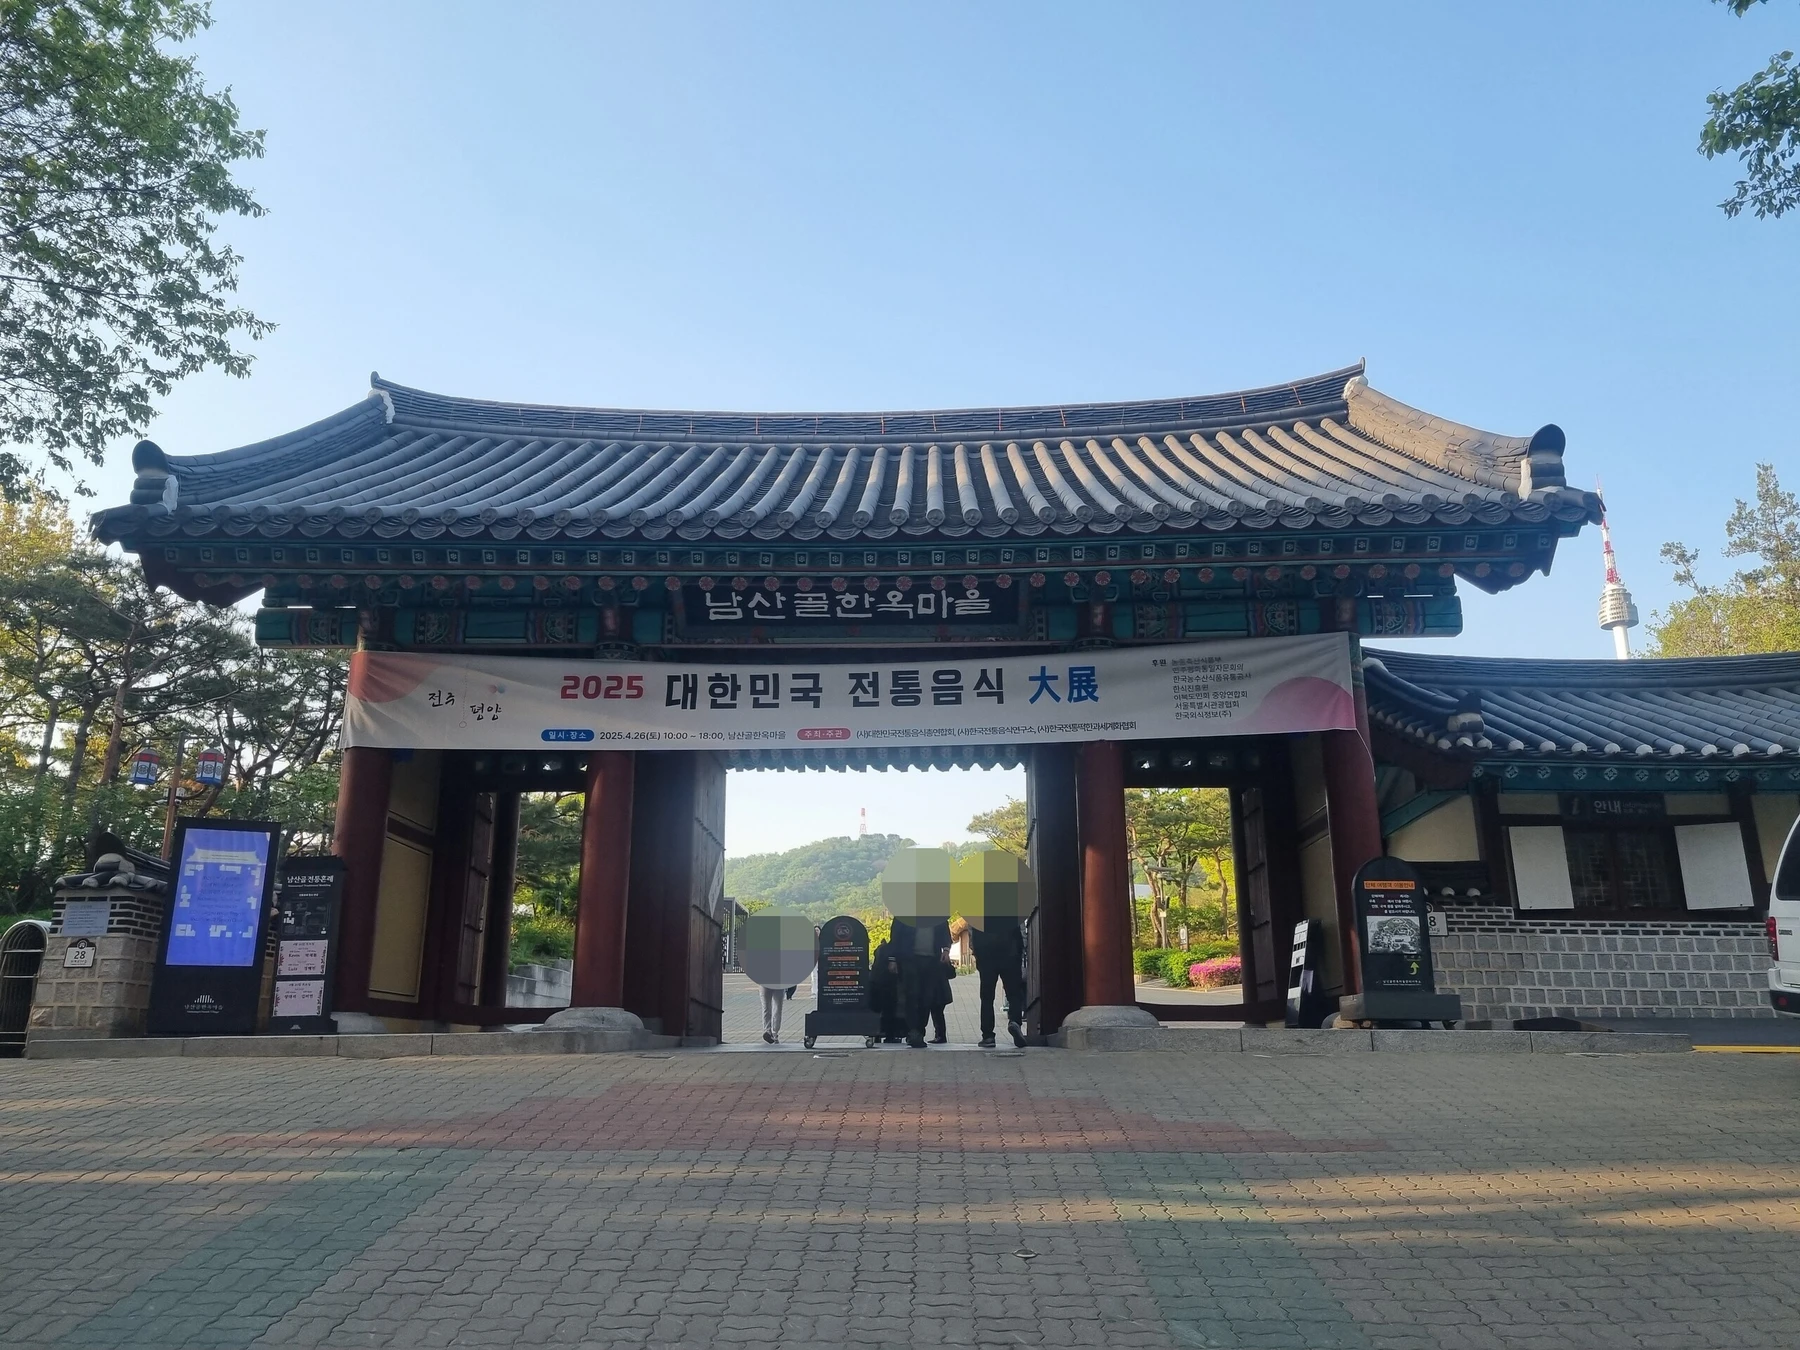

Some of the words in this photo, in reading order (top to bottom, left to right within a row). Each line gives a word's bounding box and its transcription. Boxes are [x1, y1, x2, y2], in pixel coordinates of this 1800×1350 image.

[705, 589, 992, 621] 남산골한옥마을
[560, 675, 644, 699] 2025
[666, 673, 823, 710] 대한민국
[848, 667, 1004, 708] 전통음식
[1028, 664, 1098, 704] 大展
[470, 703, 503, 721] 평양
[1174, 709, 1232, 721] 한국외식정보(주)
[548, 731, 588, 741] 일시·장소
[600, 731, 661, 742] 2025.4.26(토)
[664, 731, 689, 740] 10:00
[699, 731, 726, 742] 18:00,
[727, 730, 787, 741] 남산골한옥마을
[1594, 800, 1621, 815] 안내
[1428, 916, 1437, 927] 8
[74, 950, 87, 960] 28
